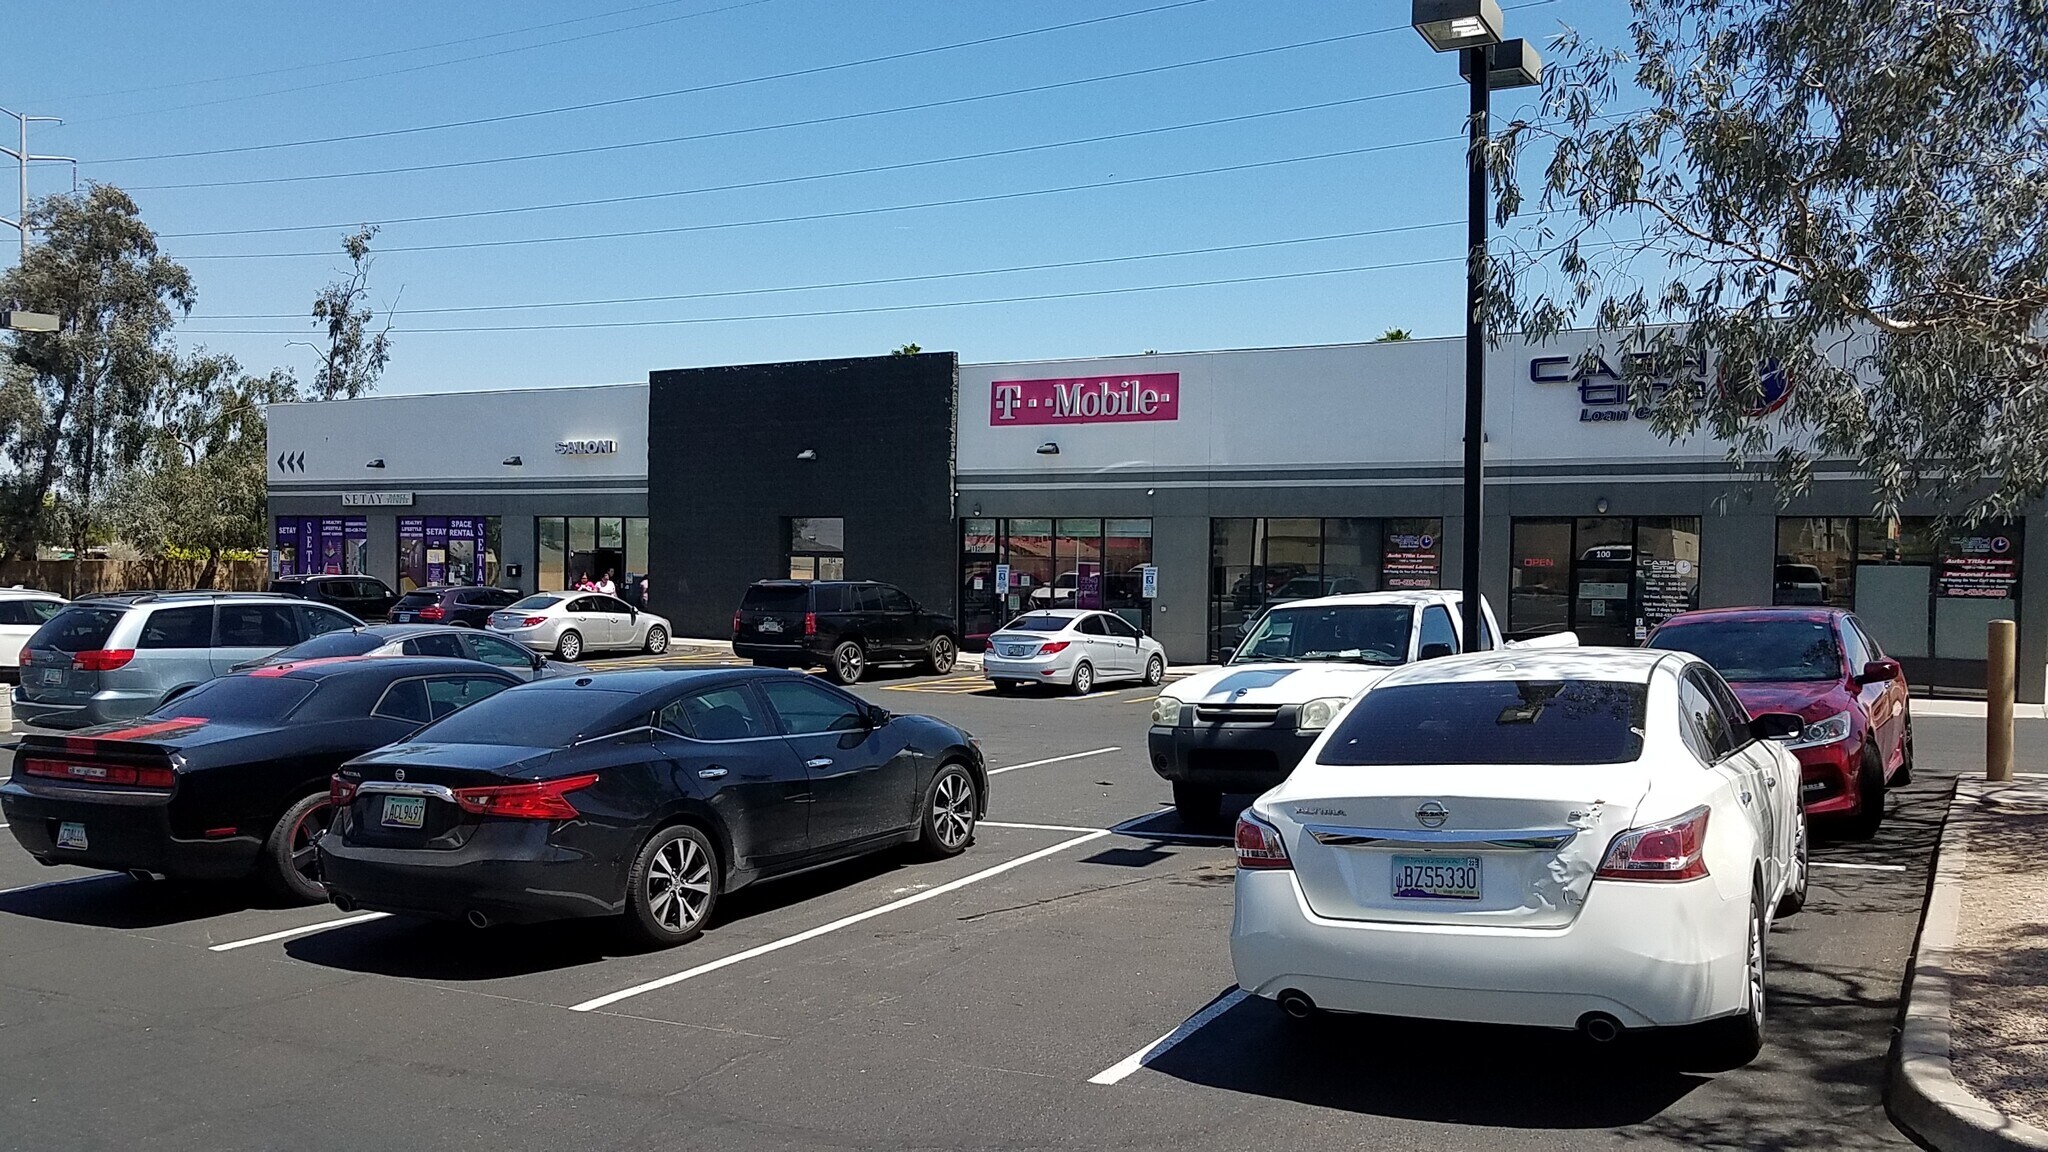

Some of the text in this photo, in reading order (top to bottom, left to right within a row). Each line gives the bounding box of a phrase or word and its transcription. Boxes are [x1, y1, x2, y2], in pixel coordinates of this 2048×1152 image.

[1530, 350, 1707, 383] CAH
[1580, 408, 1629, 422] Loan
[344, 494, 384, 505] SETAY
[278, 526, 296, 534] SETAY
[426, 528, 447, 536] SETAY
[449, 529, 474, 537] RENTAL
[305, 522, 313, 575] SETA
[476, 523, 485, 587] SETA
[1524, 558, 1553, 567] OPEN
[389, 804, 423, 820] ACL9497
[1296, 807, 1347, 817] ALTIMA
[1404, 866, 1476, 889] BZS5330
